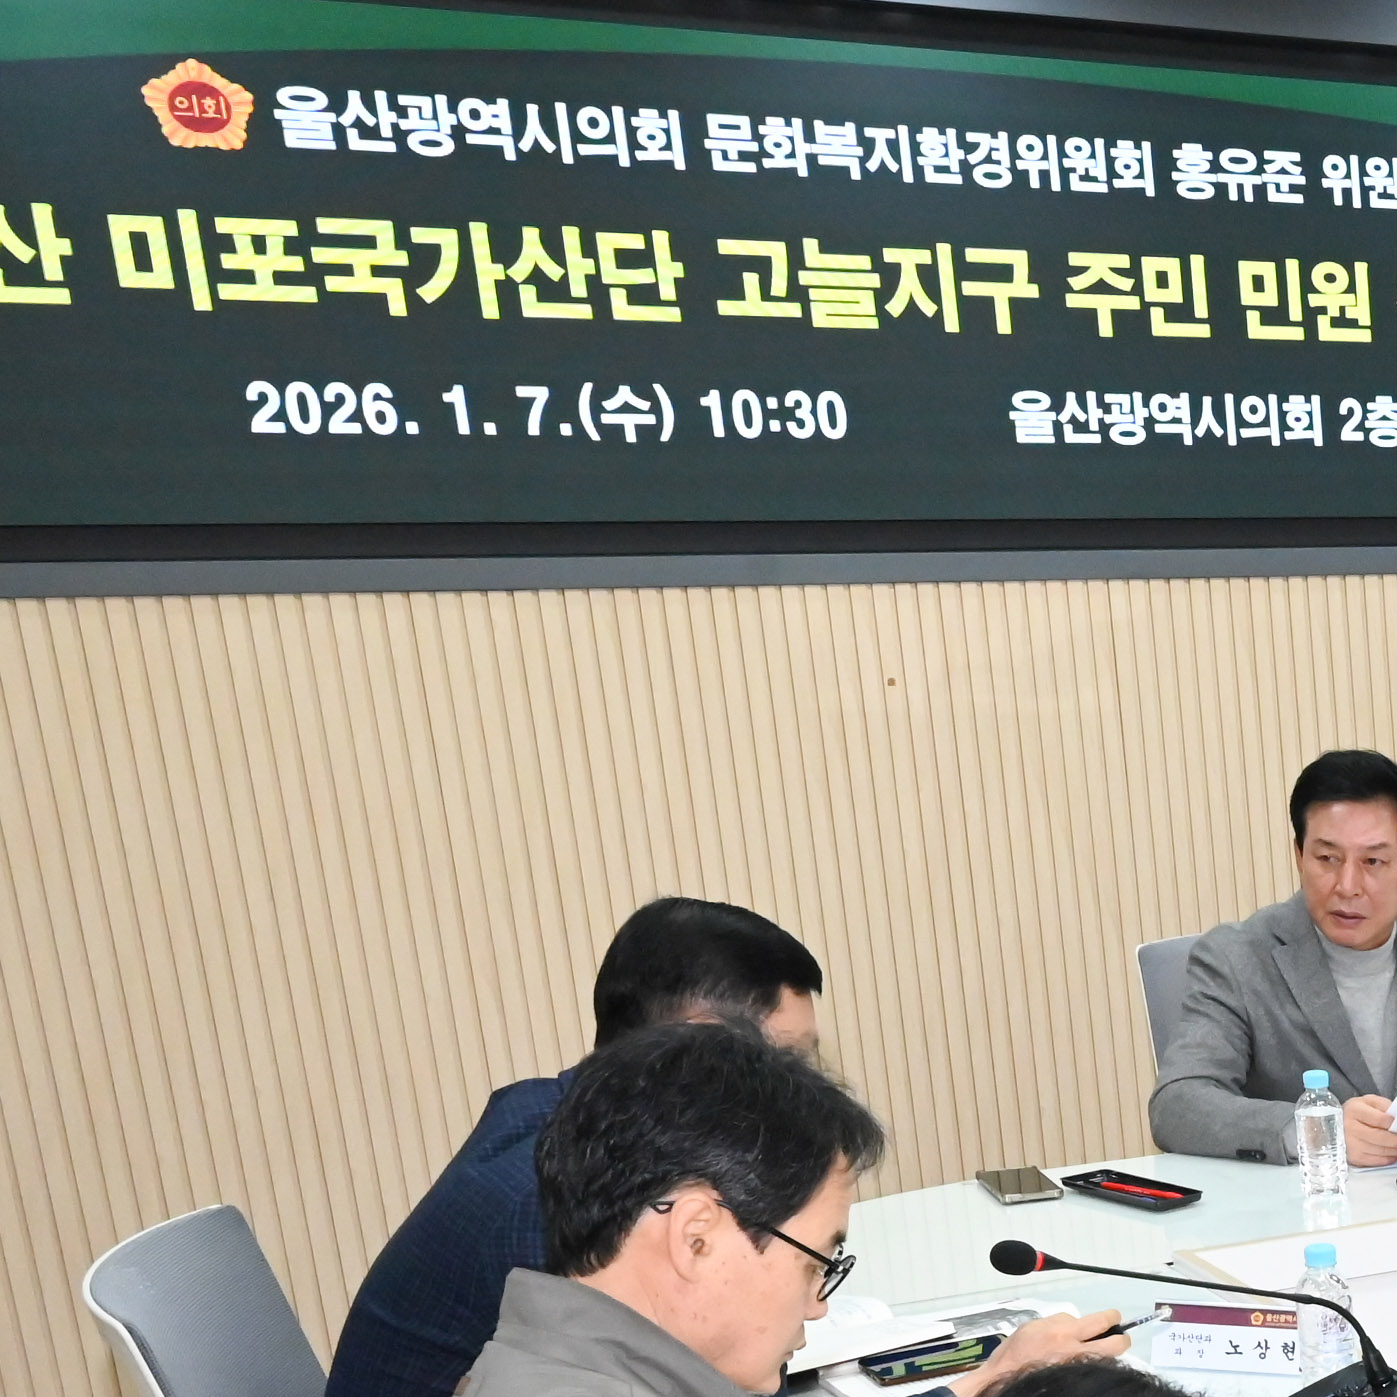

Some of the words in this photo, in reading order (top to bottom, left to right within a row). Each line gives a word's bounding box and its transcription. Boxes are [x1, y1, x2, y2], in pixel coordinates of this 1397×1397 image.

[173, 94, 228, 120] 의회
[273, 86, 687, 171] 울산광역시의회
[703, 112, 1156, 198] 문화복지환경위원회
[1171, 142, 1307, 204] 홍유준
[106, 208, 685, 323] 미포국가산단
[716, 237, 1040, 335] 고늘지구
[1065, 251, 1211, 338] 주민
[1237, 258, 1372, 343] 민원
[245, 380, 420, 436] 2026.
[441, 384, 498, 436] 1.
[514, 381, 675, 444] 7.(수)
[699, 388, 848, 441] 10:30
[1008, 389, 1324, 447] 울산광역시의회
[1168, 1331, 1212, 1344] 국가산단과
